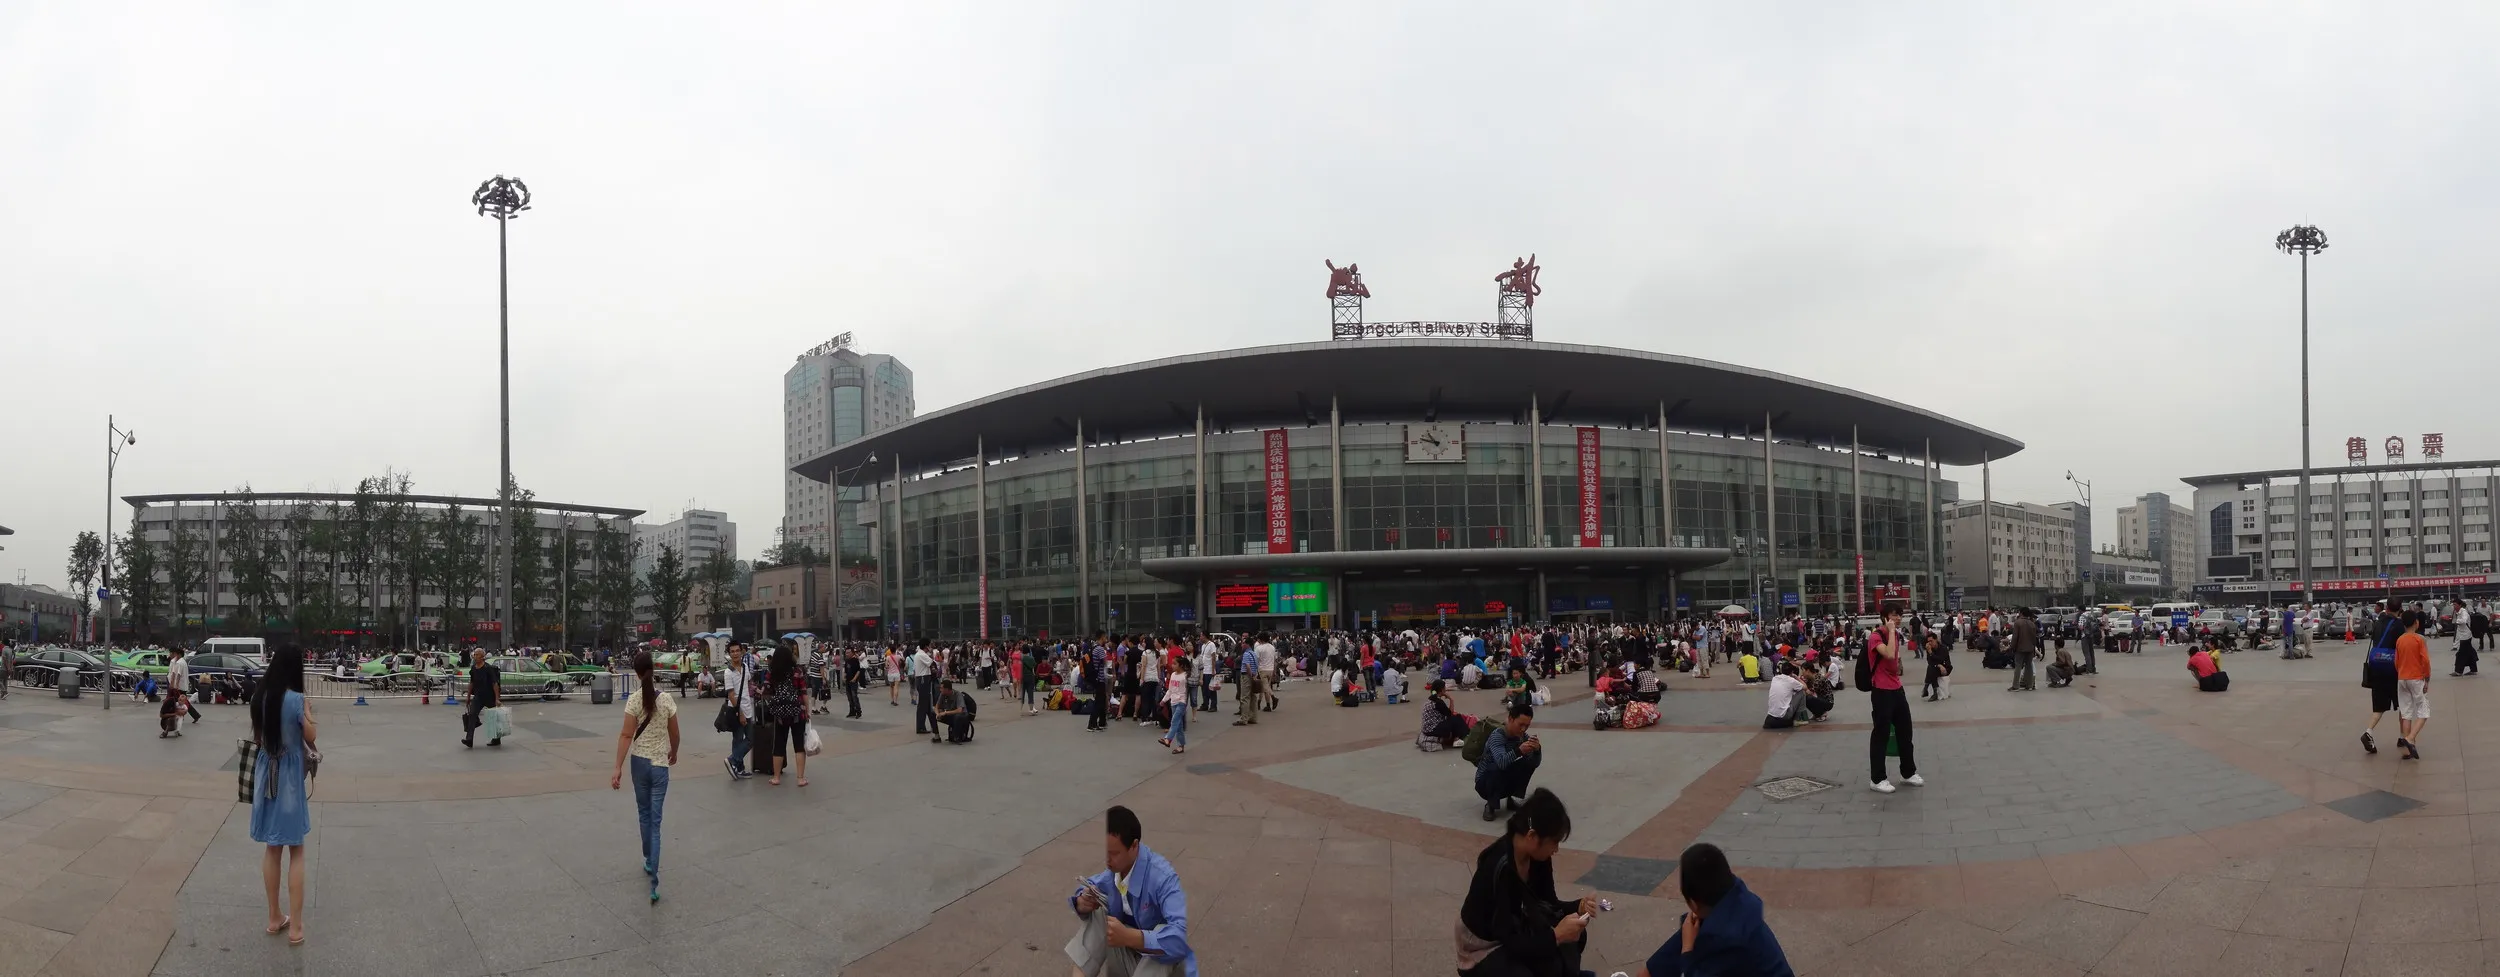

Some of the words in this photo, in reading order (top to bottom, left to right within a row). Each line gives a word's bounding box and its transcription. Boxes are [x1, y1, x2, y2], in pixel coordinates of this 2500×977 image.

[1325, 258, 1371, 299] 成
[1494, 253, 1541, 308] 都
[1333, 322, 1404, 337] Chengdu
[1411, 321, 1474, 337] Railway
[2346, 436, 2367, 459] 售
[2422, 432, 2444, 455] 票
[1269, 433, 1287, 545] 热烈庆祝中国共产党成立90周年
[1582, 430, 1597, 539] 高举中国特色社会主义伟大旗帜
